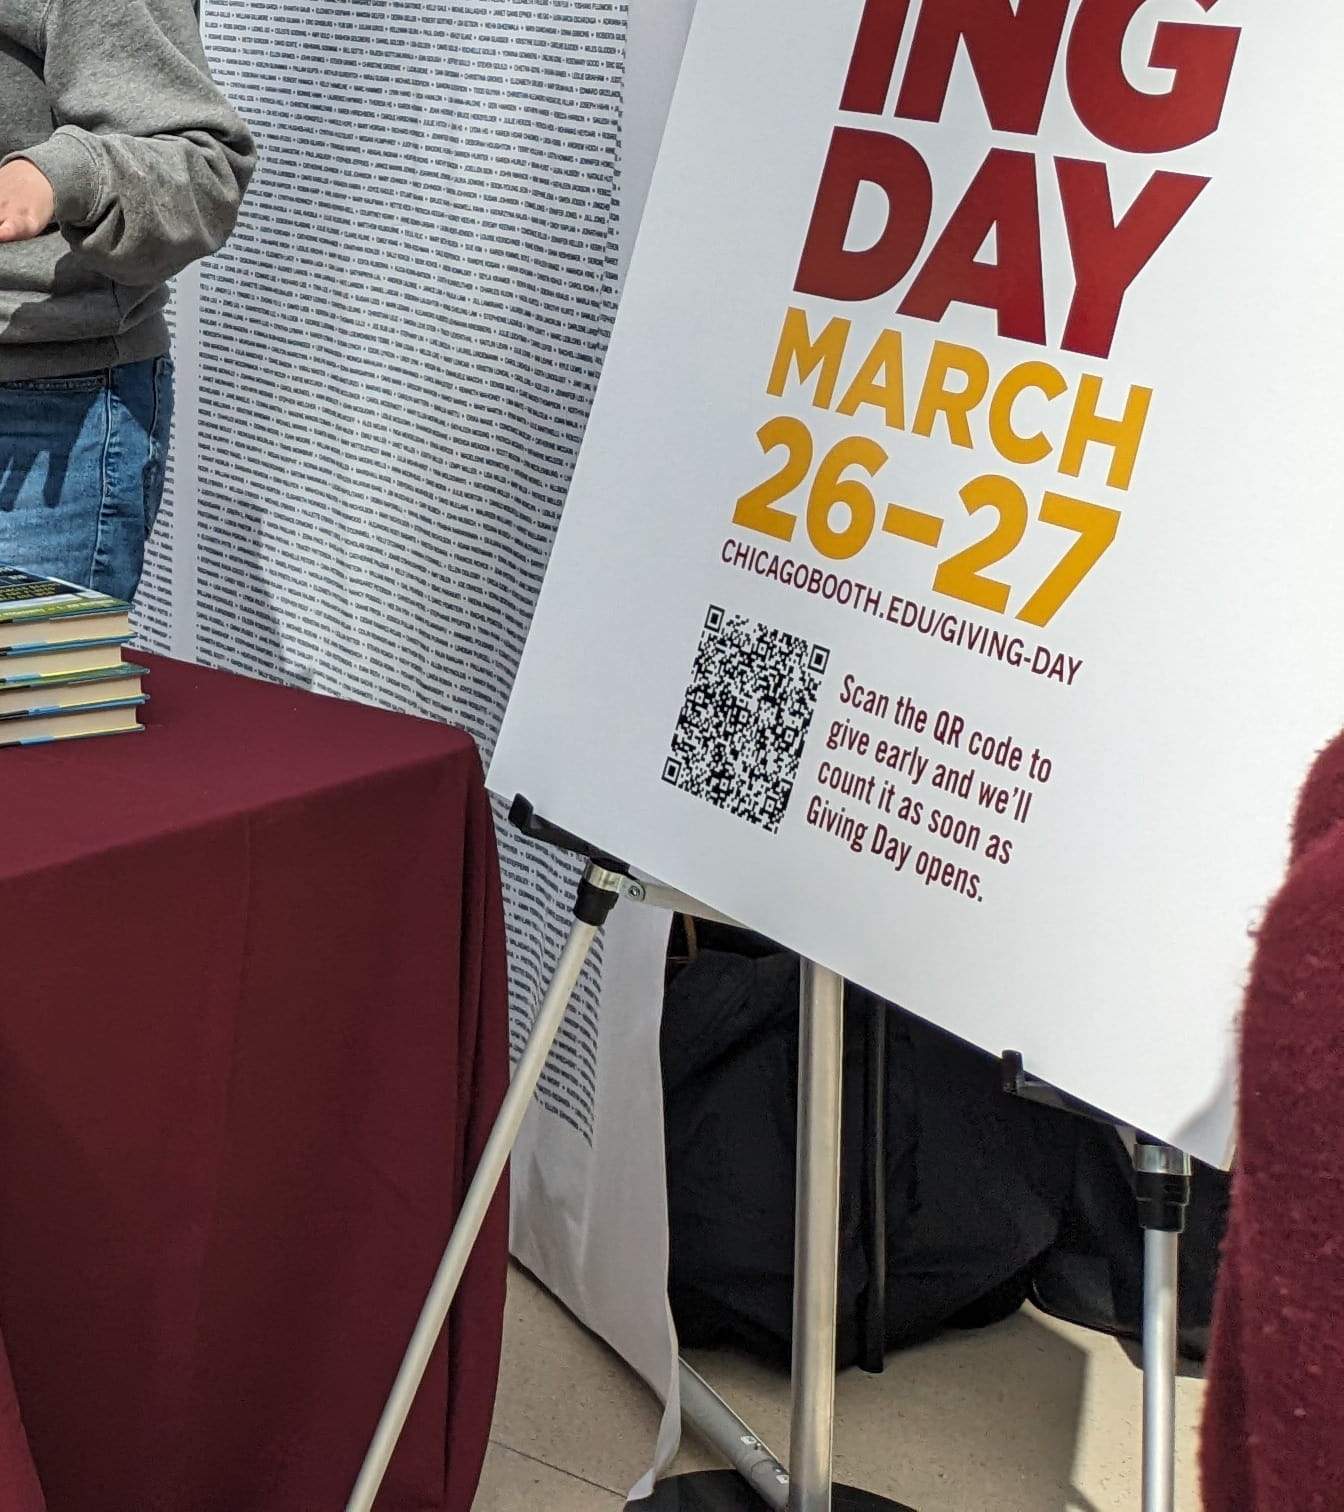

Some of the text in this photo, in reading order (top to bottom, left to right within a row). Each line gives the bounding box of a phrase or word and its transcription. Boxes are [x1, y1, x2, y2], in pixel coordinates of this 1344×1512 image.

[792, 124, 1213, 360] DAY
[765, 305, 1154, 492] MARCH
[720, 538, 1084, 688] CHICAGOBOOTH.EDU/GIVING-DAY
[826, 719, 1035, 825] give early and we'll
[838, 673, 1053, 784] Scan the QR code to
[805, 795, 985, 903] Giving Day opens.
[817, 761, 1014, 867] count it as soon as
